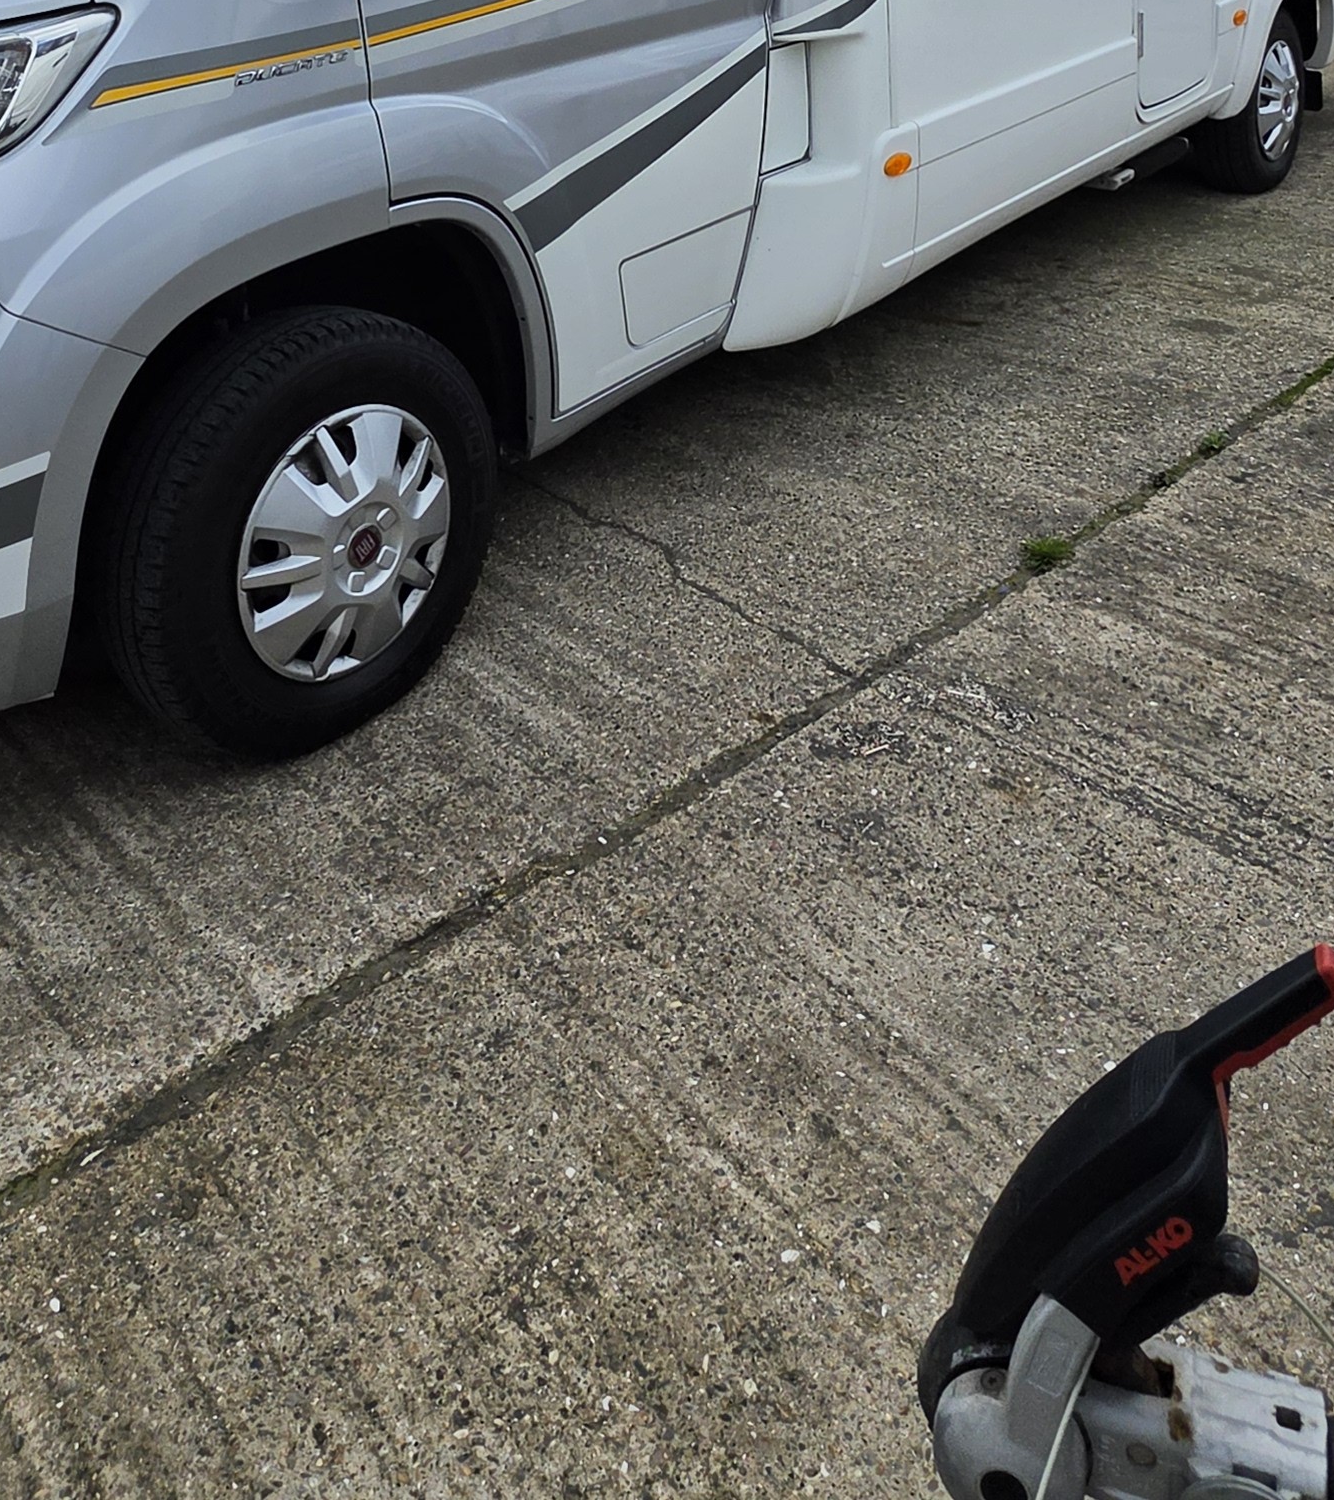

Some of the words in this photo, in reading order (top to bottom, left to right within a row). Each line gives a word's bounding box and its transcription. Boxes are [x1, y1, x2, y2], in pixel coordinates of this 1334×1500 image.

[234, 49, 349, 87] DUCATO
[355, 533, 376, 562] FIAT
[1113, 1216, 1194, 1287] AL-KO
